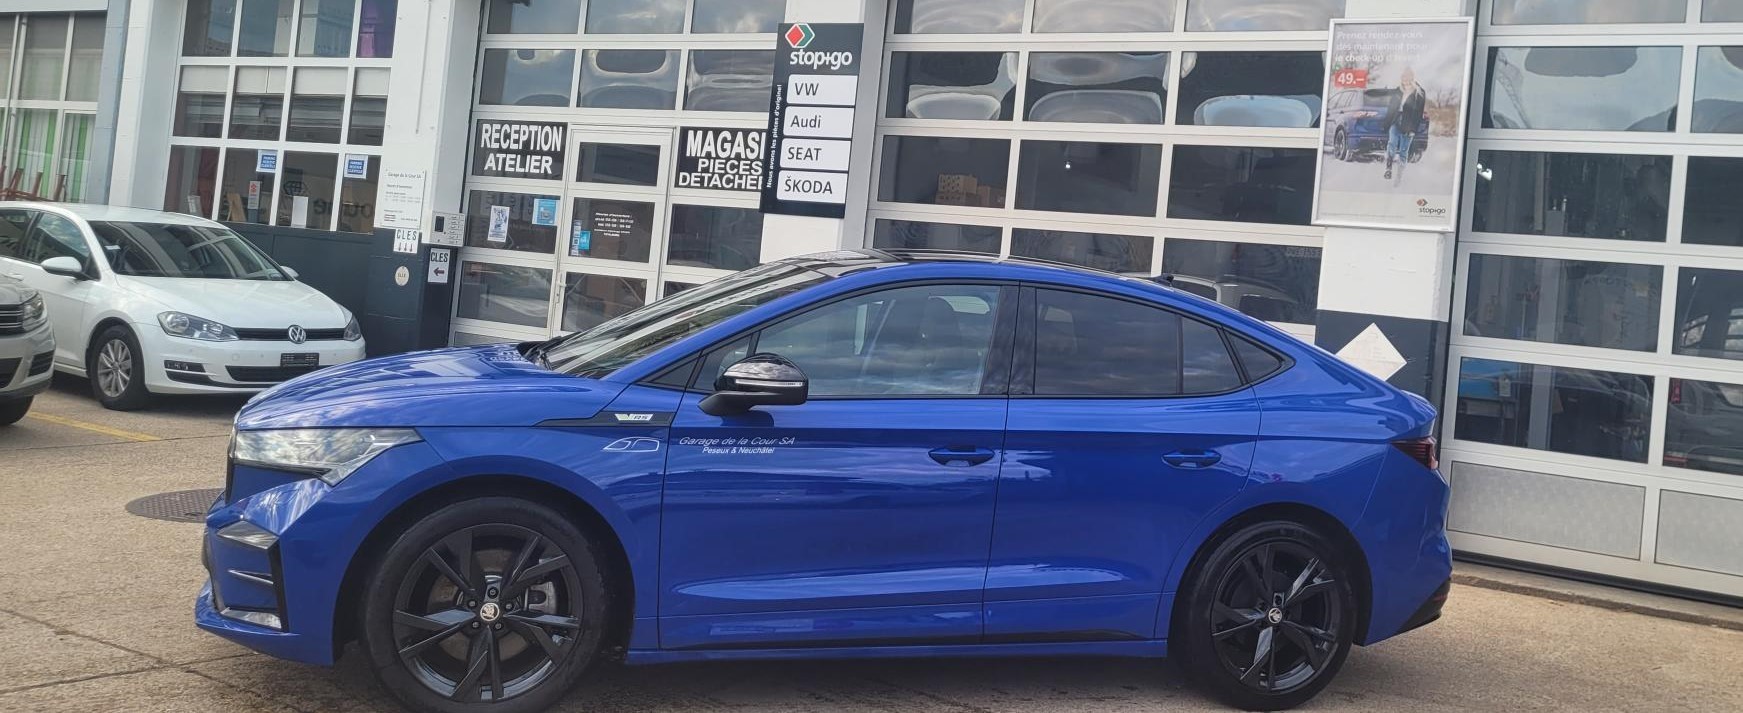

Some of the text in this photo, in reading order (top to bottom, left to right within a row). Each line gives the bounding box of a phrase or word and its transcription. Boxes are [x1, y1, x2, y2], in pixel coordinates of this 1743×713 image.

[790, 48, 853, 70] stop+go
[795, 82, 820, 96] VW
[791, 114, 822, 129] Audi
[480, 123, 563, 152] RECEPTION
[686, 129, 767, 160] MAGASI
[787, 146, 822, 161] SEAT
[483, 152, 553, 175] ATELIER
[697, 158, 763, 176] PIECES
[766, 170, 774, 188] Nous
[784, 175, 833, 194] ŠKODA
[396, 229, 418, 241] CLES
[430, 251, 449, 263] CLES
[679, 437, 796, 447] Garage de la Cour SA
[702, 446, 776, 454] Peseux & Neuchâtel
